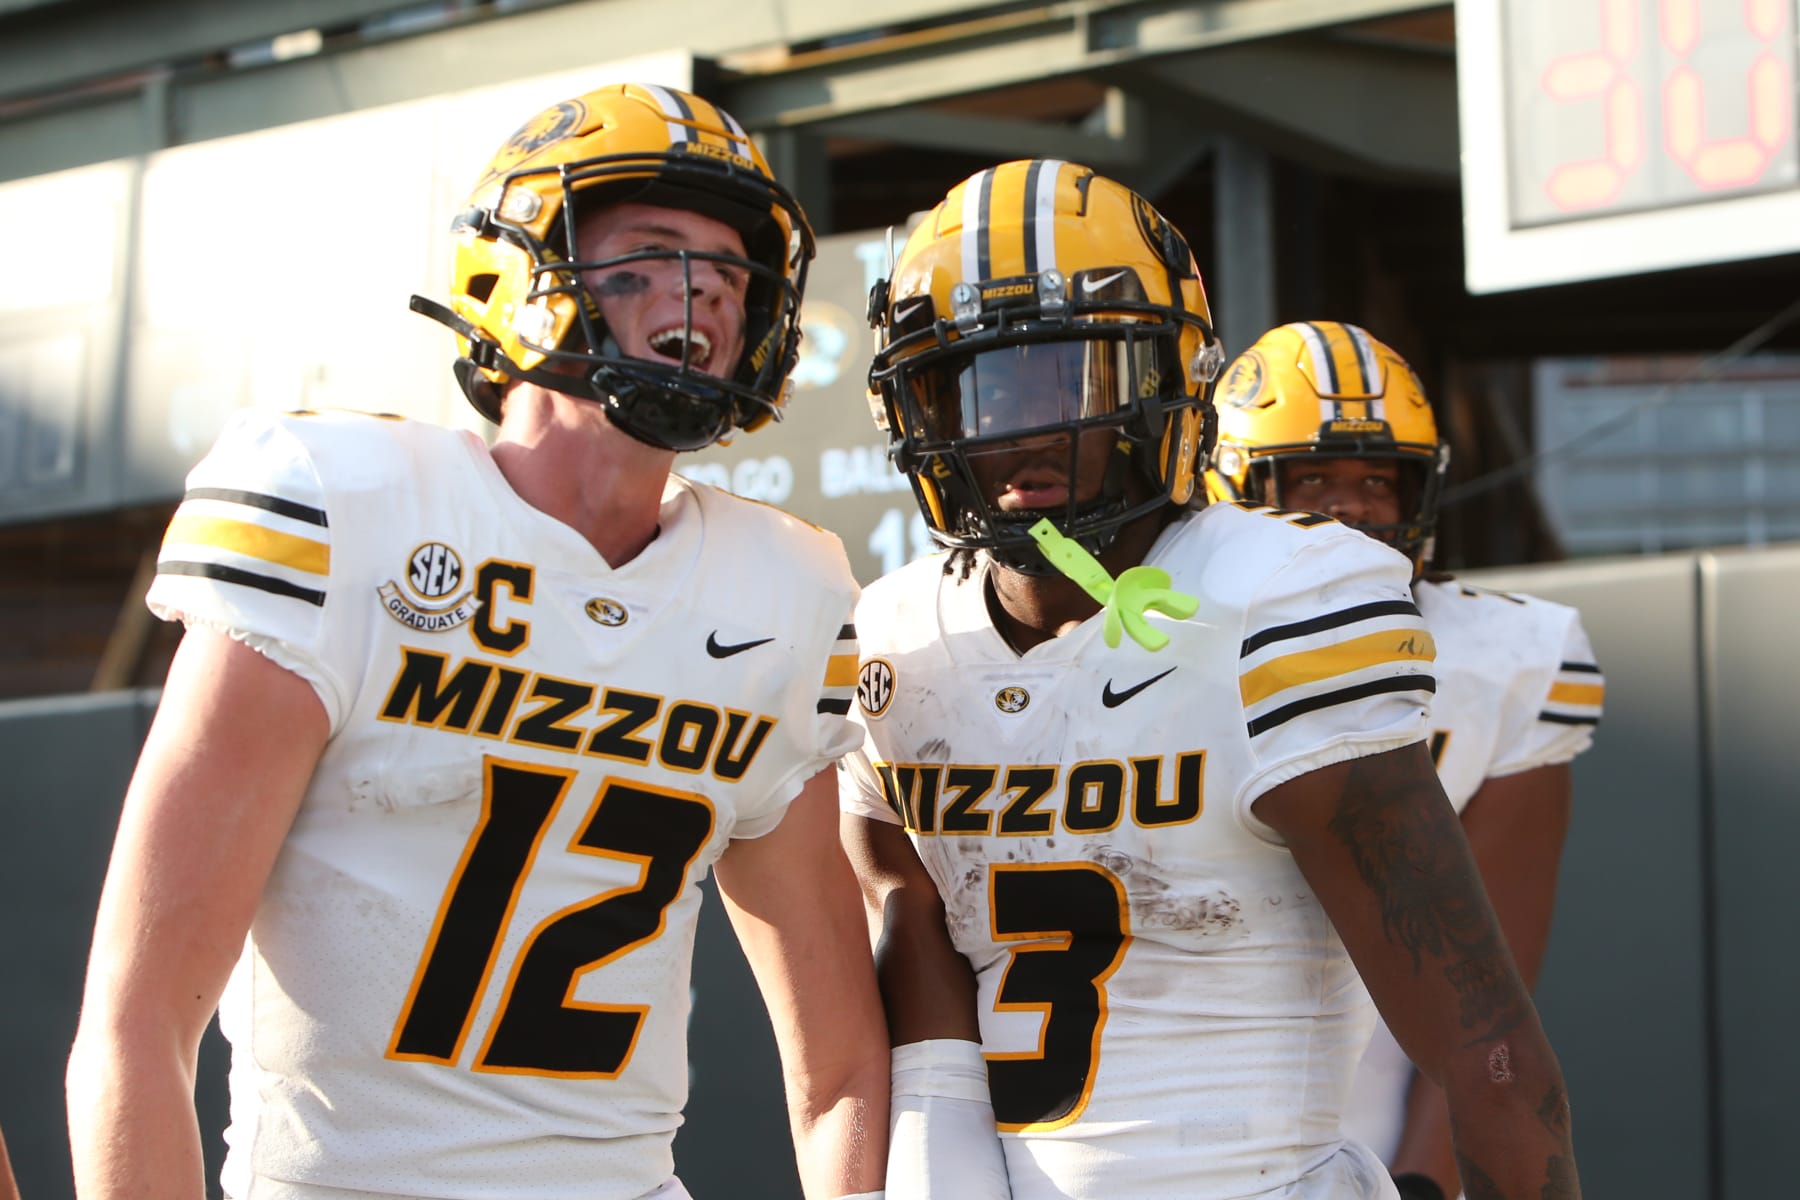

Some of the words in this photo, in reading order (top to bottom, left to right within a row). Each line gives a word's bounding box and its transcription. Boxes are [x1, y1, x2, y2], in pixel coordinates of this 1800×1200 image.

[686, 142, 754, 171] MIZZOU
[982, 283, 1034, 301] MIZZOU
[1330, 420, 1385, 433] MIZZOU
[408, 542, 463, 598] SEC
[388, 597, 468, 631] GRADUATE
[468, 557, 536, 658] C
[376, 645, 778, 783] MIZZOU
[857, 660, 894, 715] SEC
[384, 753, 717, 1081] 12
[981, 861, 1134, 1134] 3
